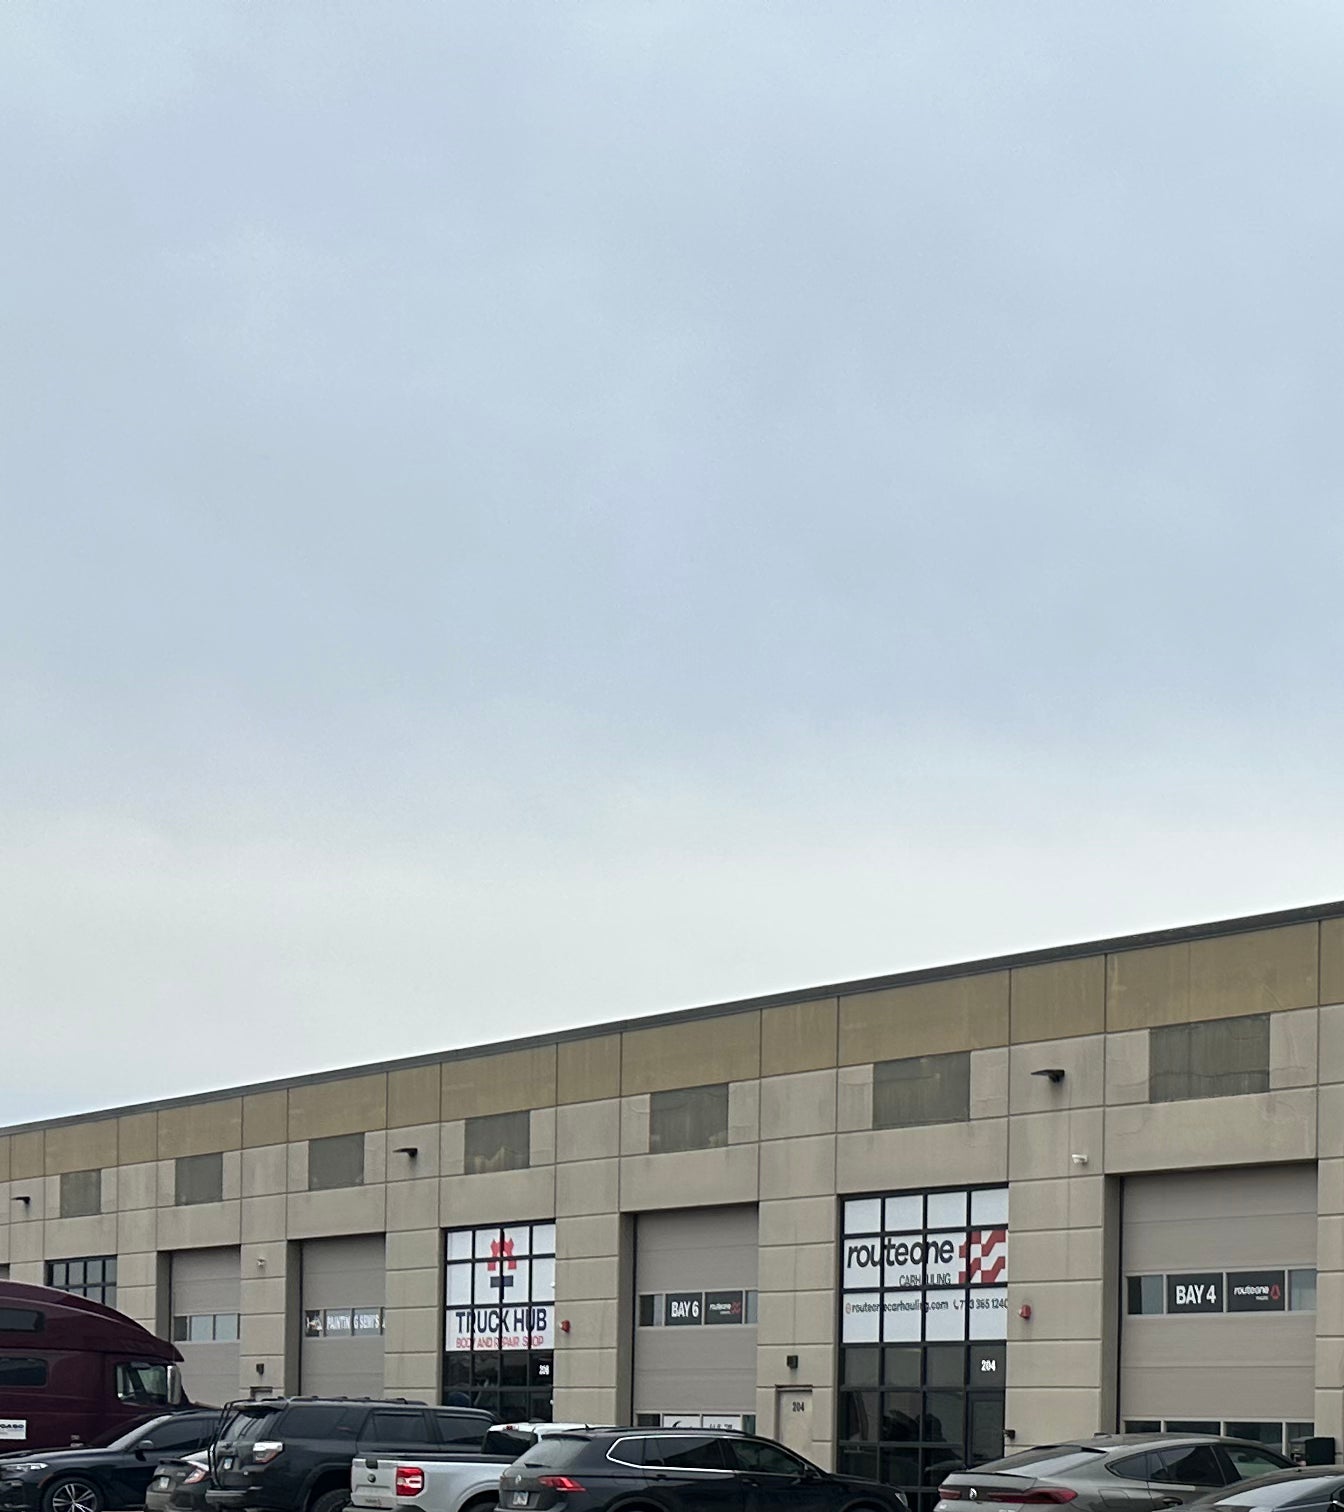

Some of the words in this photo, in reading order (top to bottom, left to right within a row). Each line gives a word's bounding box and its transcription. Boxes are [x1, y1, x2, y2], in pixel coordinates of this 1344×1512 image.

[847, 1238, 954, 1268] routeone
[1176, 1285, 1204, 1304] BAY
[1206, 1285, 1216, 1303] 4
[671, 1301, 690, 1317] BAY
[692, 1301, 699, 1317] 6
[456, 1310, 510, 1334] TRUCK
[514, 1308, 547, 1332] HUB
[494, 1336, 520, 1348] RPAIR
[522, 1336, 544, 1347] SOP
[981, 1359, 996, 1371] 204
